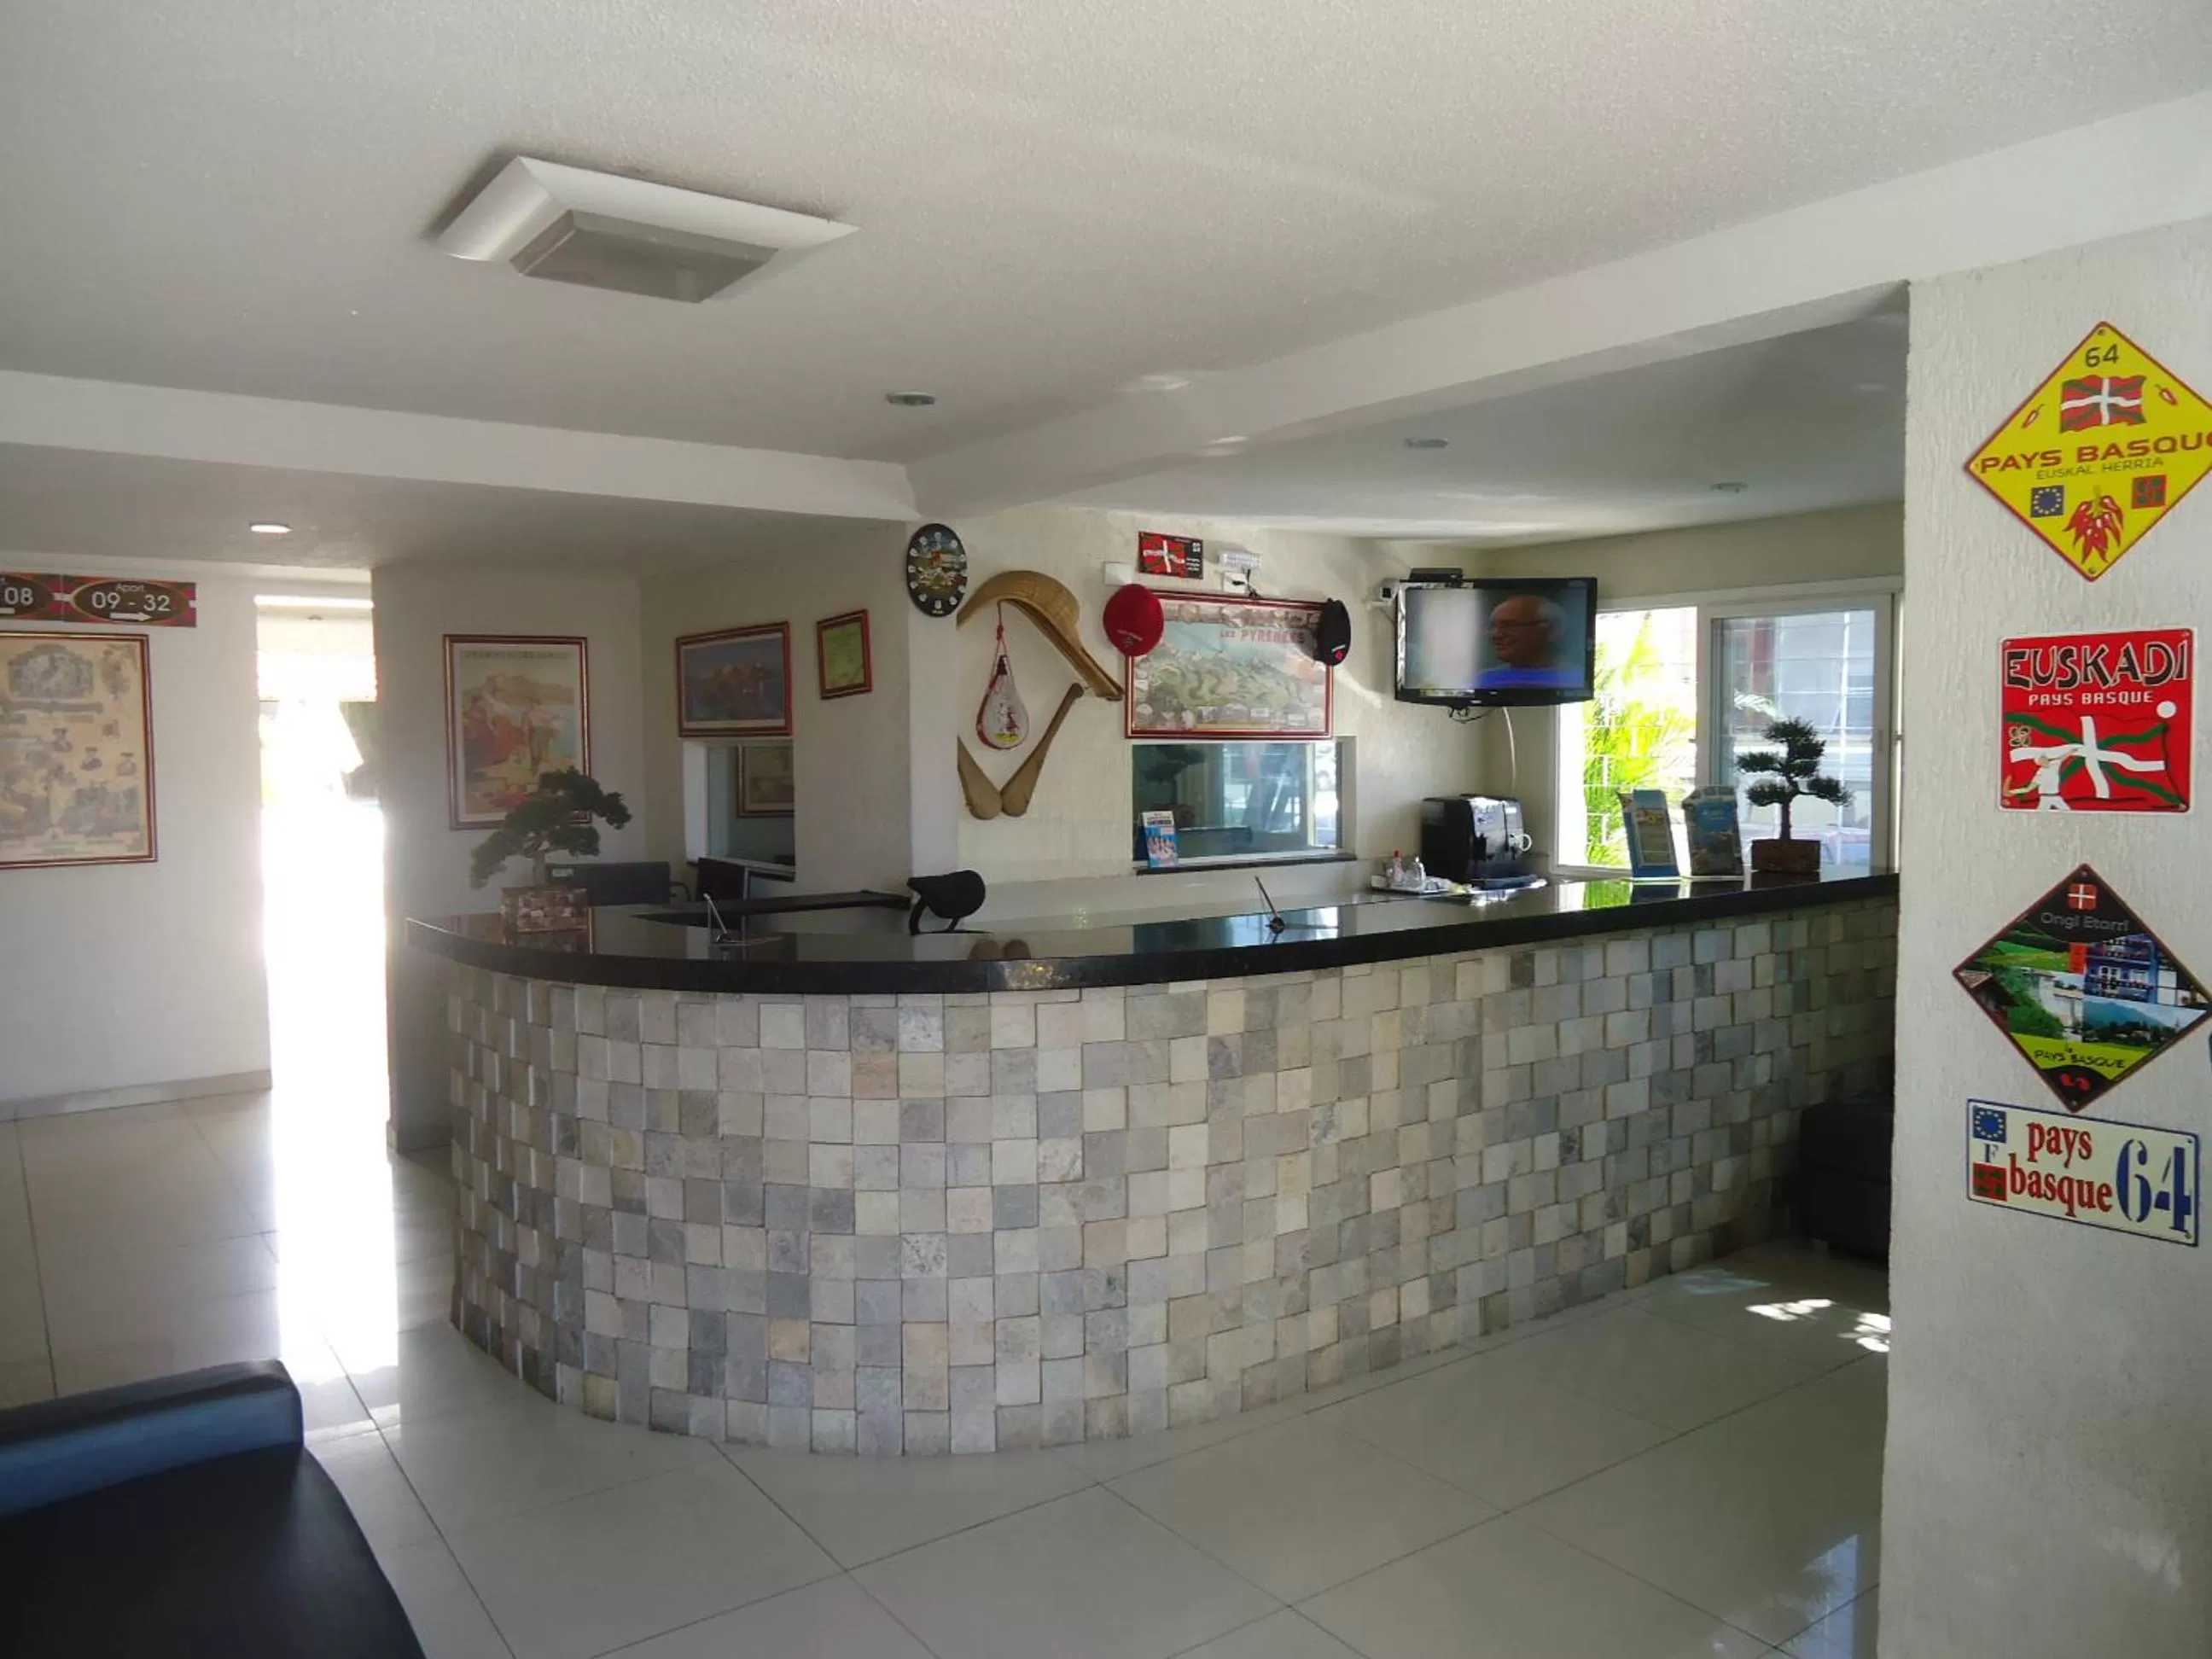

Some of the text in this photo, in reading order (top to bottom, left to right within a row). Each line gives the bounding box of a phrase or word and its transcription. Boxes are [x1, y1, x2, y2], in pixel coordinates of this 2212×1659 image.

[2085, 344, 2120, 367] 64
[1980, 449, 2063, 474] PAYS
[2036, 457, 2164, 480] EUSKAL HERRIA
[3, 587, 34, 605] 08
[91, 591, 121, 609] 09
[143, 595, 172, 612] 32
[2004, 640, 2188, 690] EUSKADI
[2029, 690, 2155, 706] PAYS BASQUE
[2040, 911, 2080, 930] Ongi
[2034, 1049, 2125, 1068] PAYS BASQUE
[1983, 1143, 1999, 1163] F
[2026, 1122, 2093, 1169] pays
[2008, 1153, 2113, 1218] basque
[2116, 1138, 2192, 1233] 64
